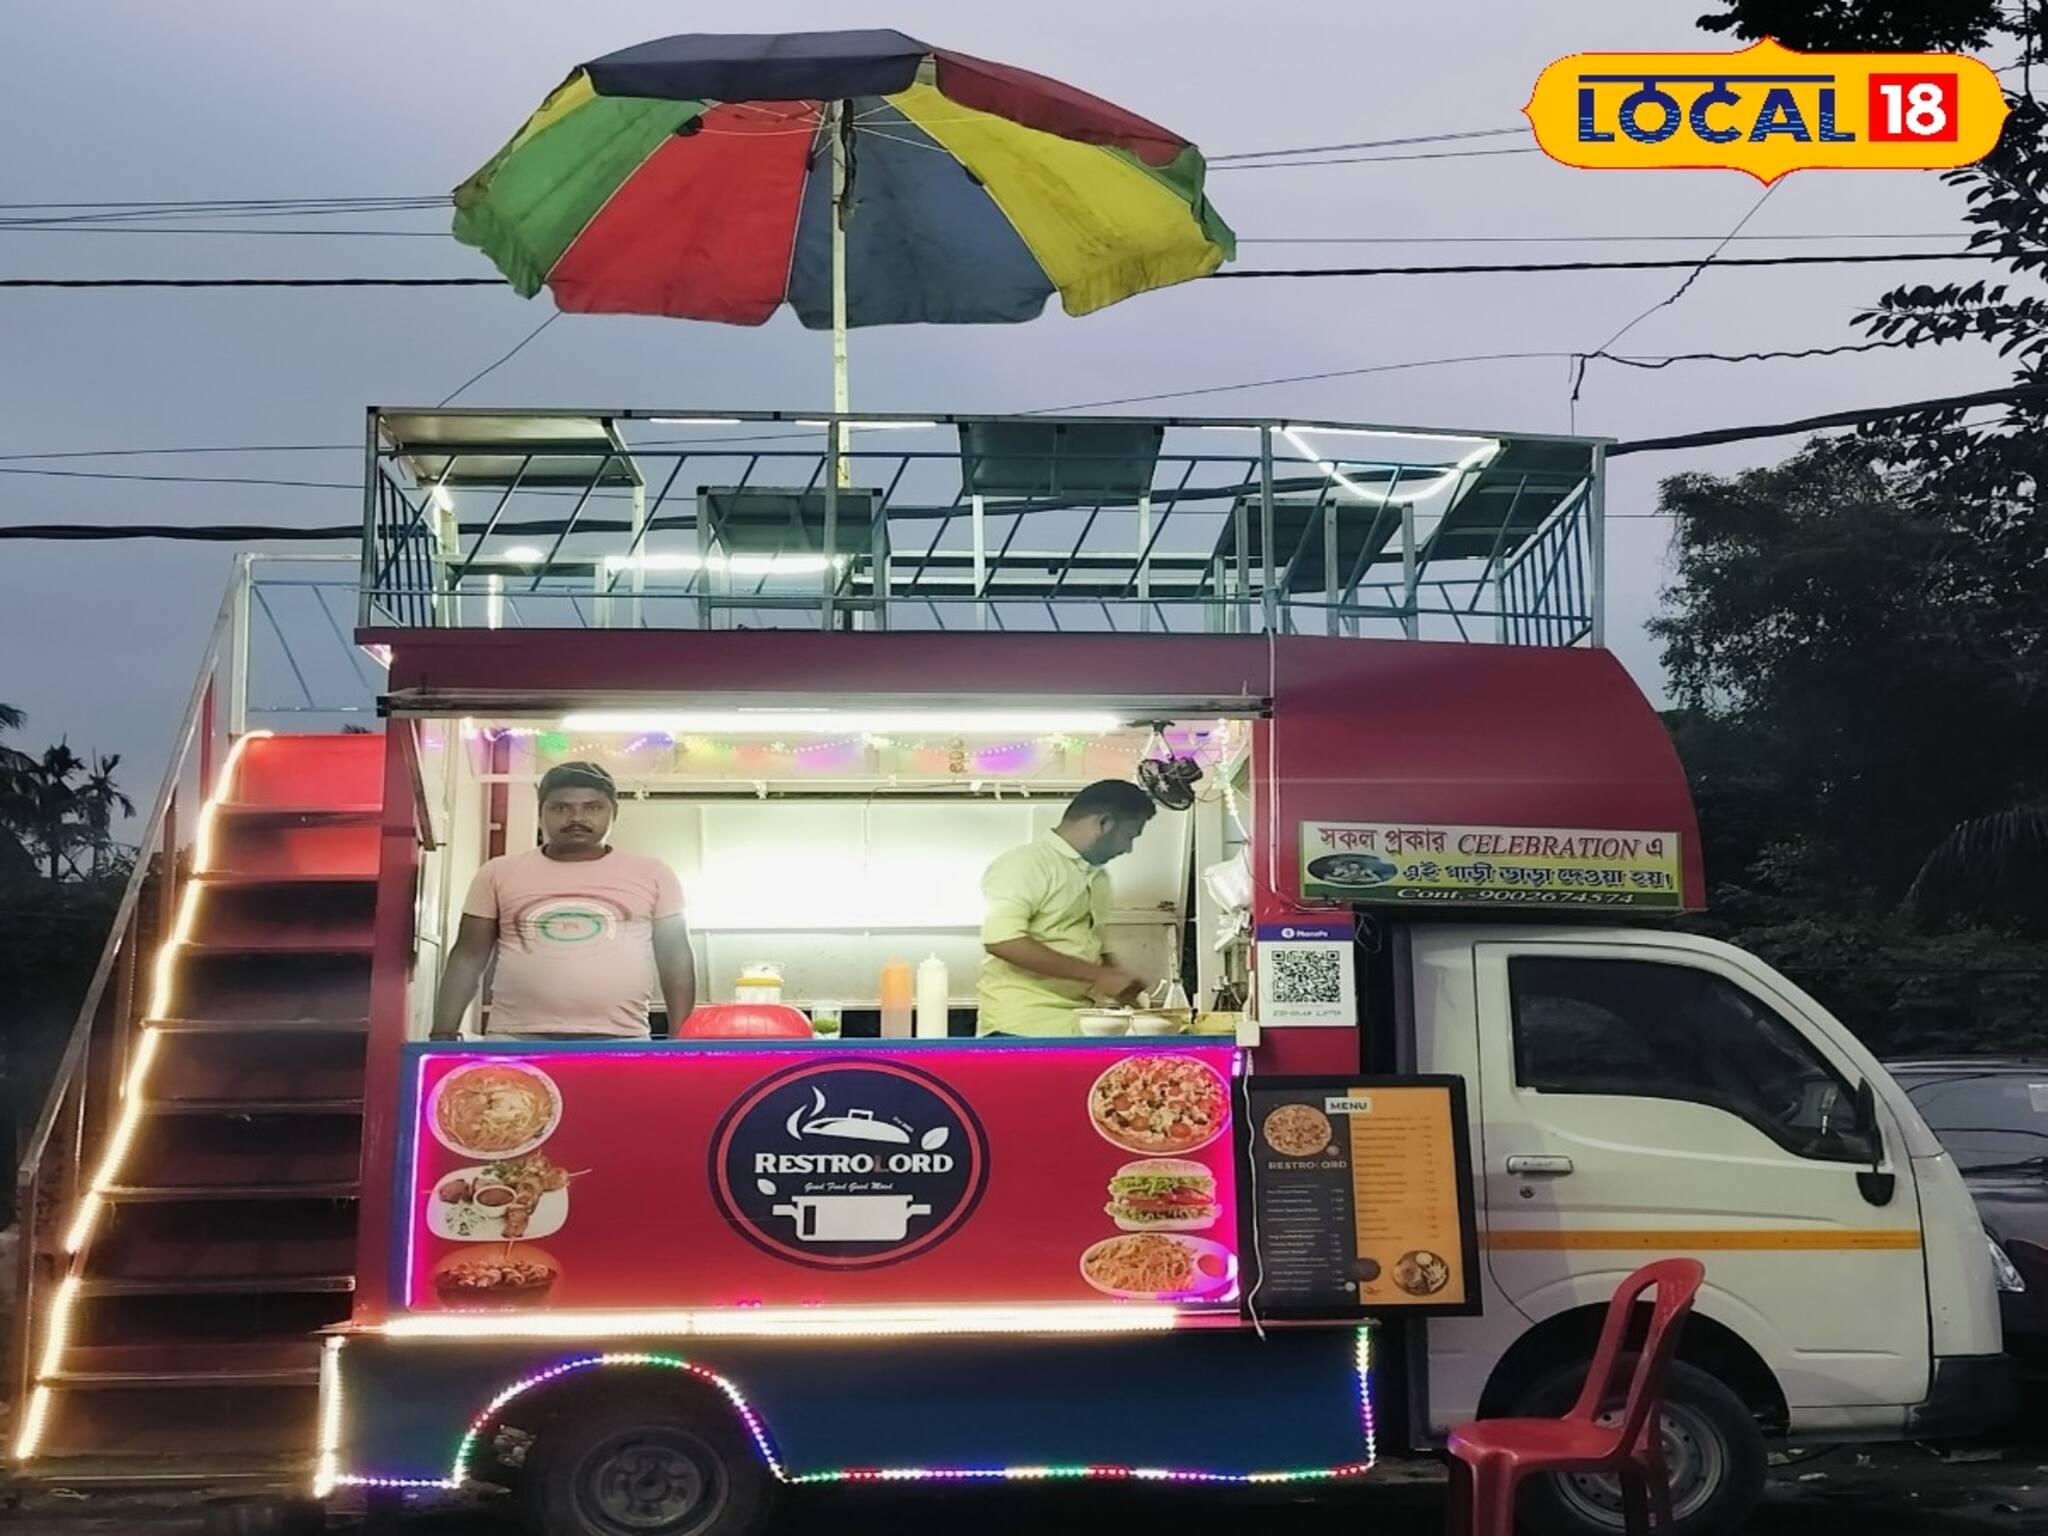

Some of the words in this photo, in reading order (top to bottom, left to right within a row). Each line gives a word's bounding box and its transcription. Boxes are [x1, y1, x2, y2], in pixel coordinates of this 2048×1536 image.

[1318, 828, 1377, 851] সকল
[1385, 827, 1448, 856] প্রকার
[1457, 833, 1642, 861] CELEBRATION
[1645, 837, 1664, 859] এ
[1402, 860, 1442, 883] এই
[1330, 1101, 1369, 1111] MENU
[754, 1153, 954, 1174] RESTROLORD
[804, 1182, 825, 1193] Good
[848, 1182, 870, 1193] Good
[870, 1182, 895, 1191] Mood
